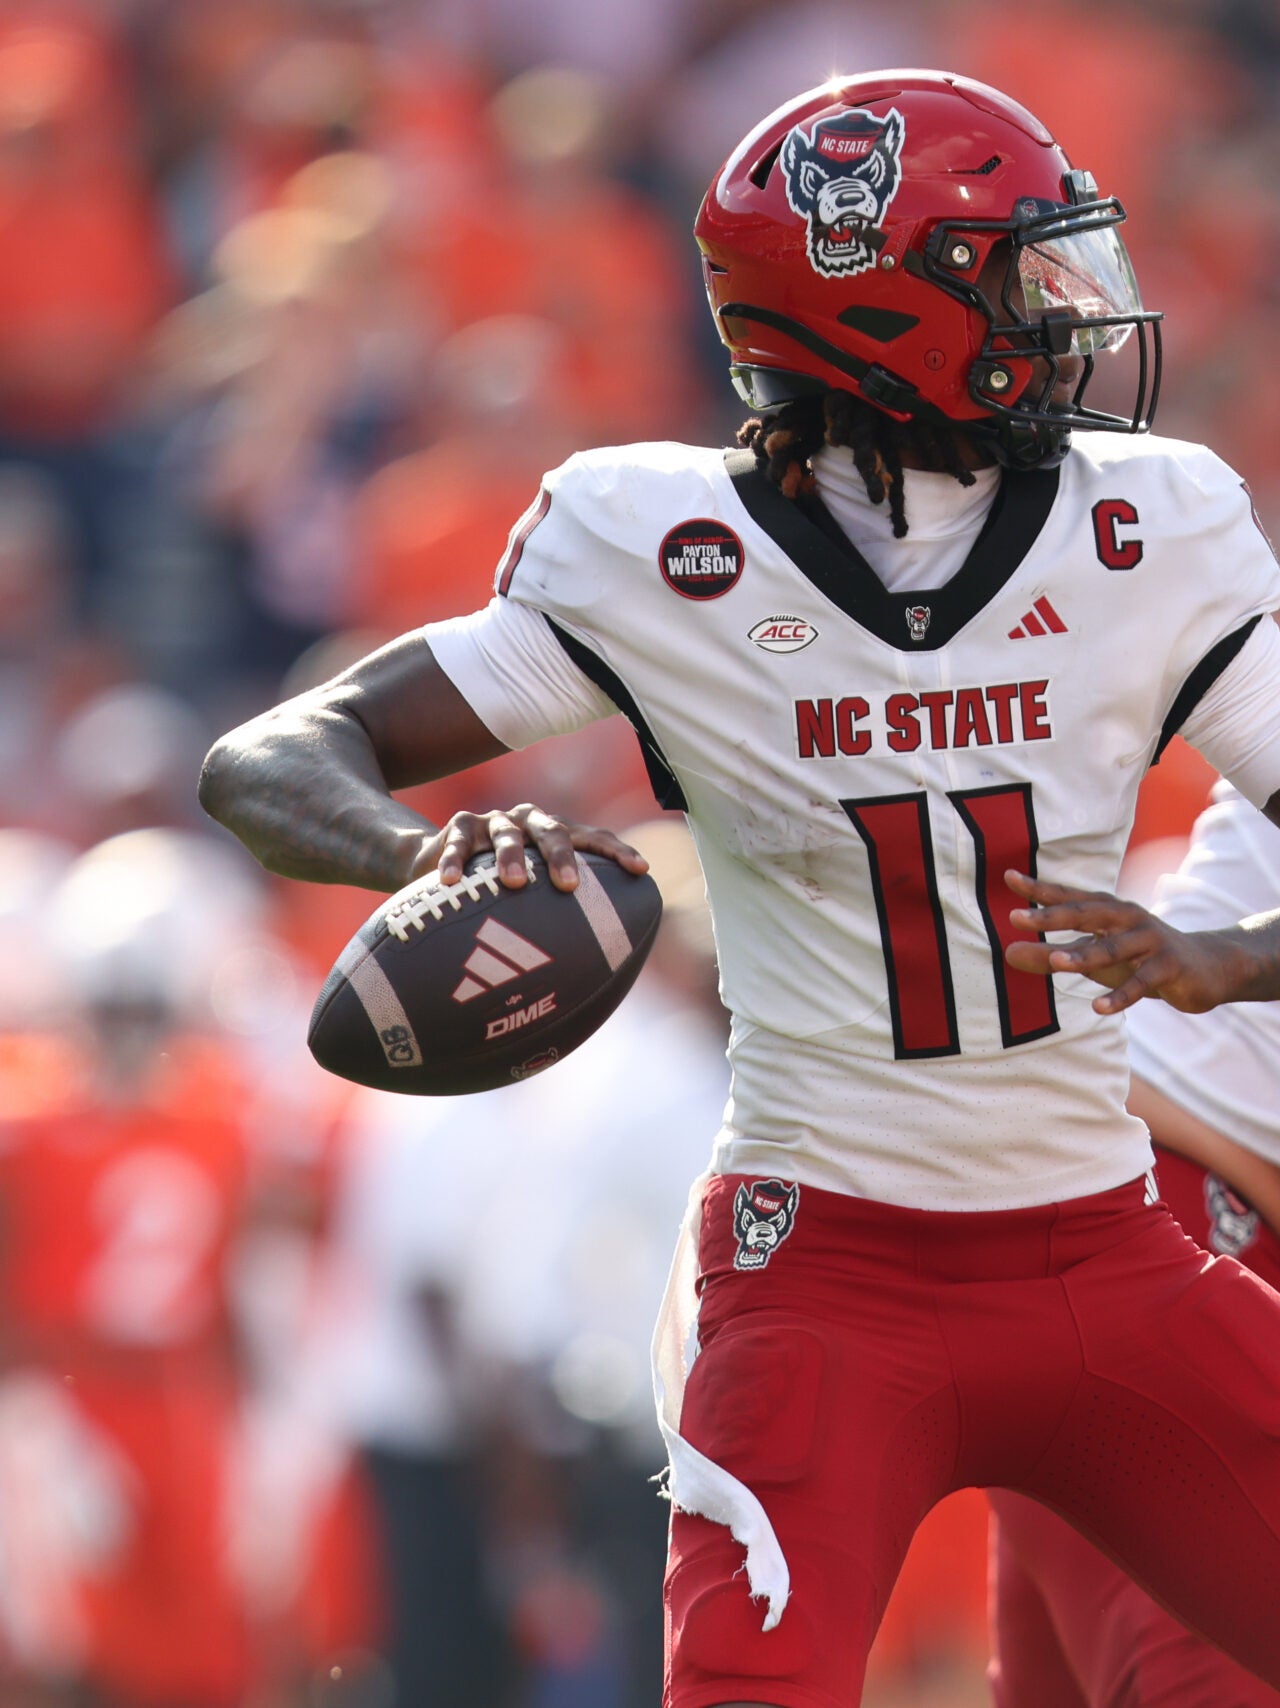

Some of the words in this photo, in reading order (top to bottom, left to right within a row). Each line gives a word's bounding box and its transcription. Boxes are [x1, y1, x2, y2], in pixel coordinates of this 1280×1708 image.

[821, 137, 836, 152] NC
[836, 140, 870, 154] STATE
[683, 545, 720, 557] PAYTON
[1092, 499, 1143, 570] C
[668, 556, 737, 576] WILSON
[758, 625, 808, 639] ACC
[795, 698, 872, 758] NC
[885, 679, 1052, 753] STATE
[838, 783, 1061, 1060] 11
[485, 991, 557, 1040] DIME
[380, 1024, 414, 1063] QB
